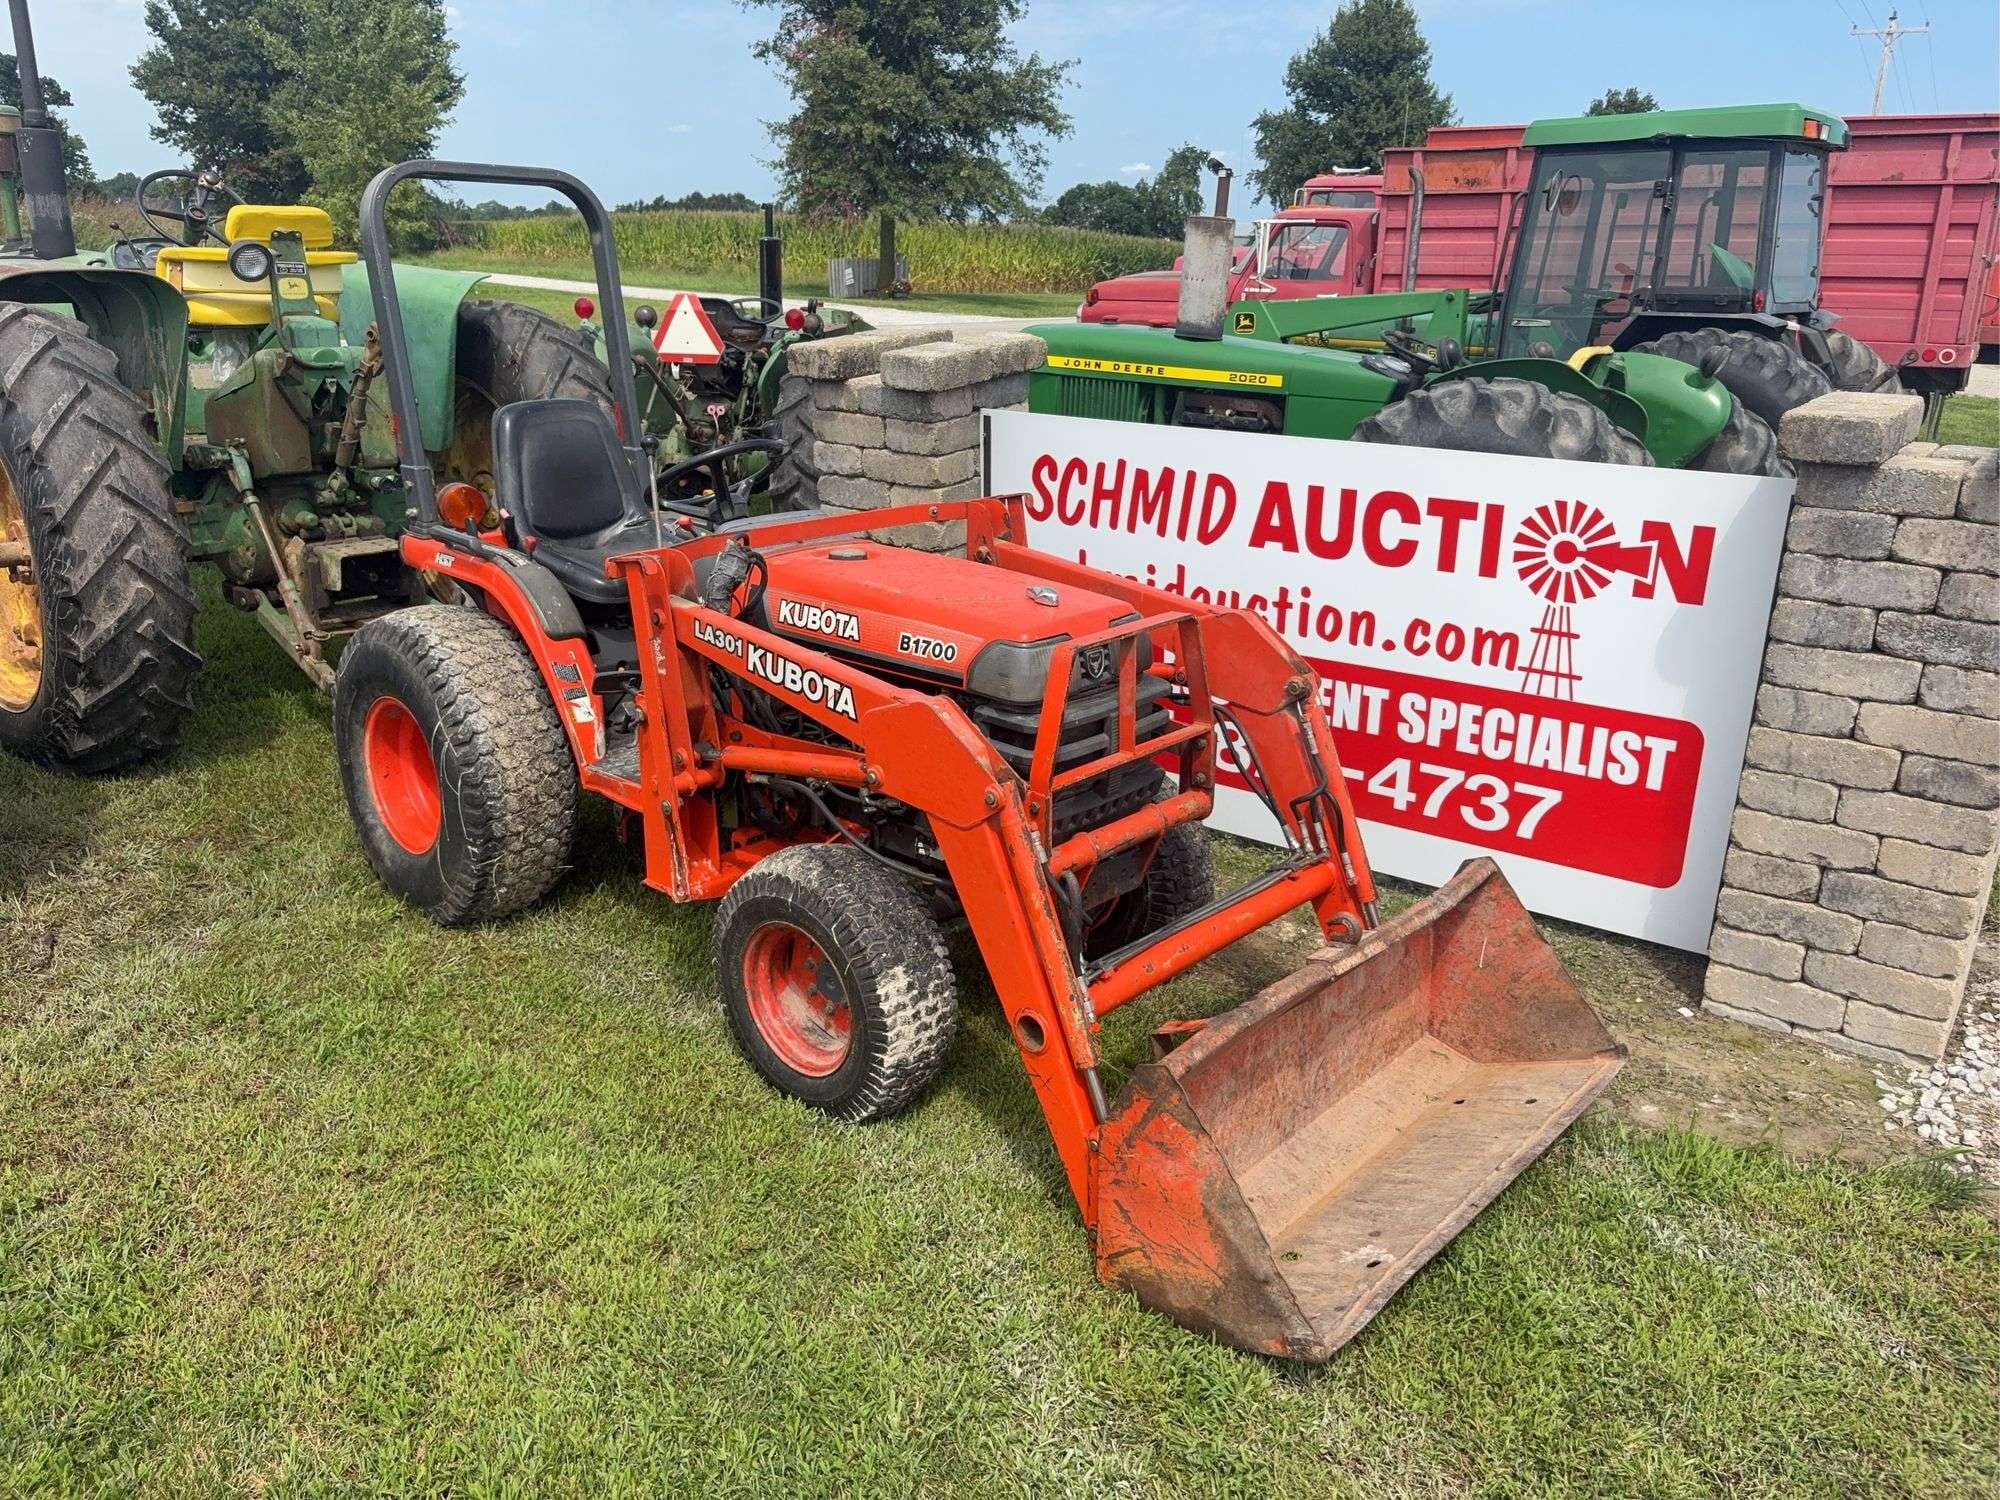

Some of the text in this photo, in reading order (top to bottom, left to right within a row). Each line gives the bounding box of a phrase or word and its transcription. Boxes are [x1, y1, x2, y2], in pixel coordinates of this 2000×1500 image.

[1063, 358, 1268, 384] JOHN DEERE 2020
[1026, 453, 1237, 546] SCHMID
[778, 599, 860, 641] KUBOTA
[898, 632, 957, 663] B1700
[693, 619, 744, 657] LA301
[747, 643, 859, 722] KUBOTA
[1397, 691, 1677, 792] SPECIALIST
